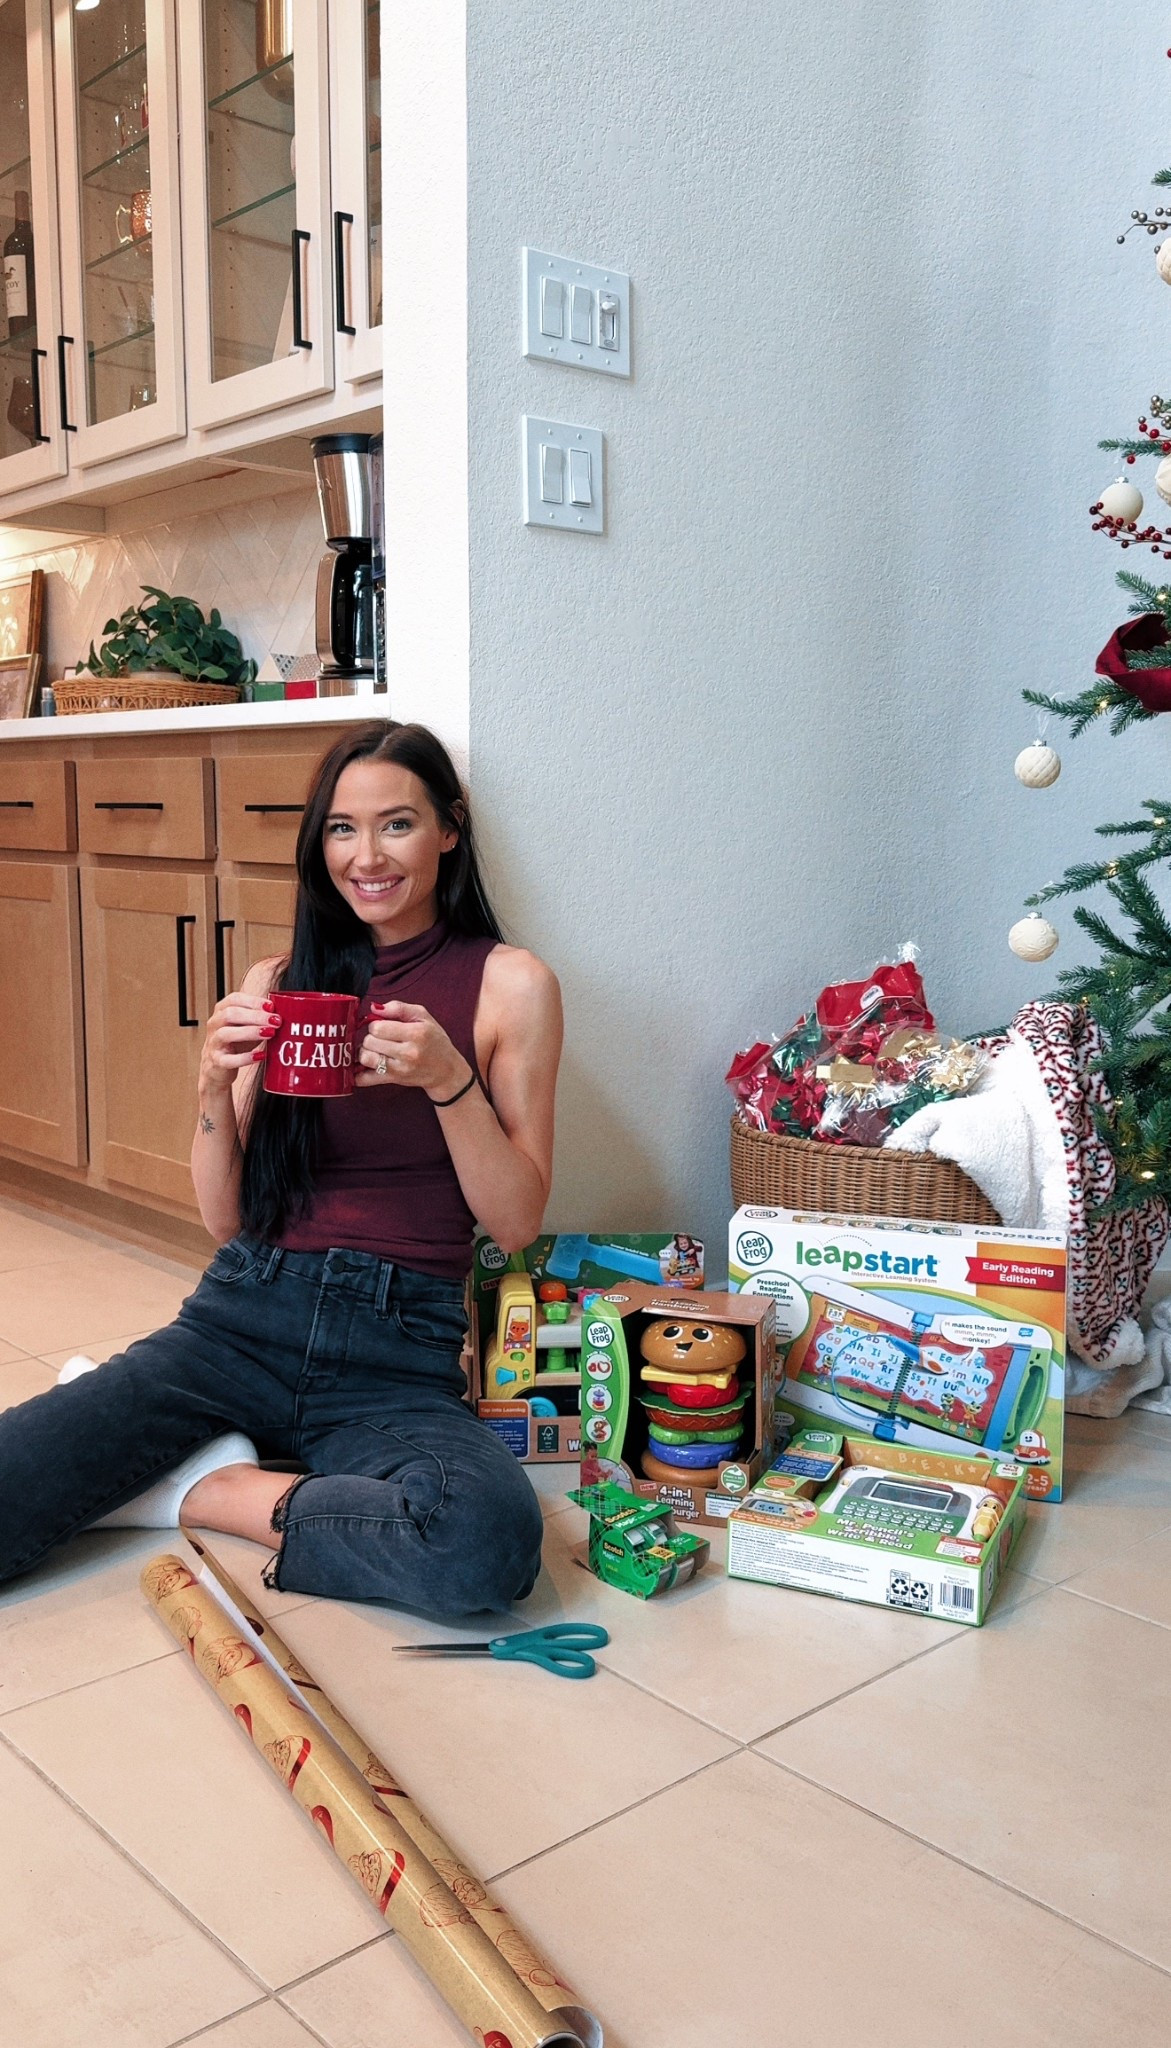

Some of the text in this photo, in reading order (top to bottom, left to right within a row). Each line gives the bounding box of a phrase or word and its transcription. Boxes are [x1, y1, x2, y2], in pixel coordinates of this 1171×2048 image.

[290, 1022, 347, 1037] MOMMY
[278, 1040, 352, 1068] CLAUS
[974, 1229, 1063, 1242] leapstart
[741, 1237, 765, 1250] Leap
[485, 1252, 506, 1266] Frog
[743, 1247, 768, 1259] Frog
[796, 1241, 938, 1276] leapstart
[982, 1262, 1055, 1278] Early Reading
[757, 1279, 790, 1287] Preschool
[851, 1271, 938, 1284] Interactive Learning System
[999, 1274, 1036, 1285] Edition
[752, 1291, 794, 1300] Foundations
[759, 1285, 787, 1294] Reading
[590, 1326, 608, 1335] Leap
[843, 1326, 859, 1337] Aa
[592, 1334, 610, 1343] Frog
[962, 1336, 990, 1344] monkey!
[940, 1353, 953, 1363] Ee
[859, 1357, 875, 1369] Qq
[881, 1364, 894, 1374] Rr
[875, 1376, 890, 1387] Xx
[972, 1374, 989, 1385] Nn
[907, 1385, 918, 1395] Yy
[943, 1381, 957, 1391] Uu
[966, 1386, 981, 1397] Vv
[656, 1495, 695, 1510] Learning
[836, 1517, 915, 1538] Mr. Pencil's
[844, 1526, 901, 1542] Scribble,
[827, 1528, 861, 1540] Write
[879, 1538, 913, 1550] Read
[603, 1542, 624, 1557] Scotch
